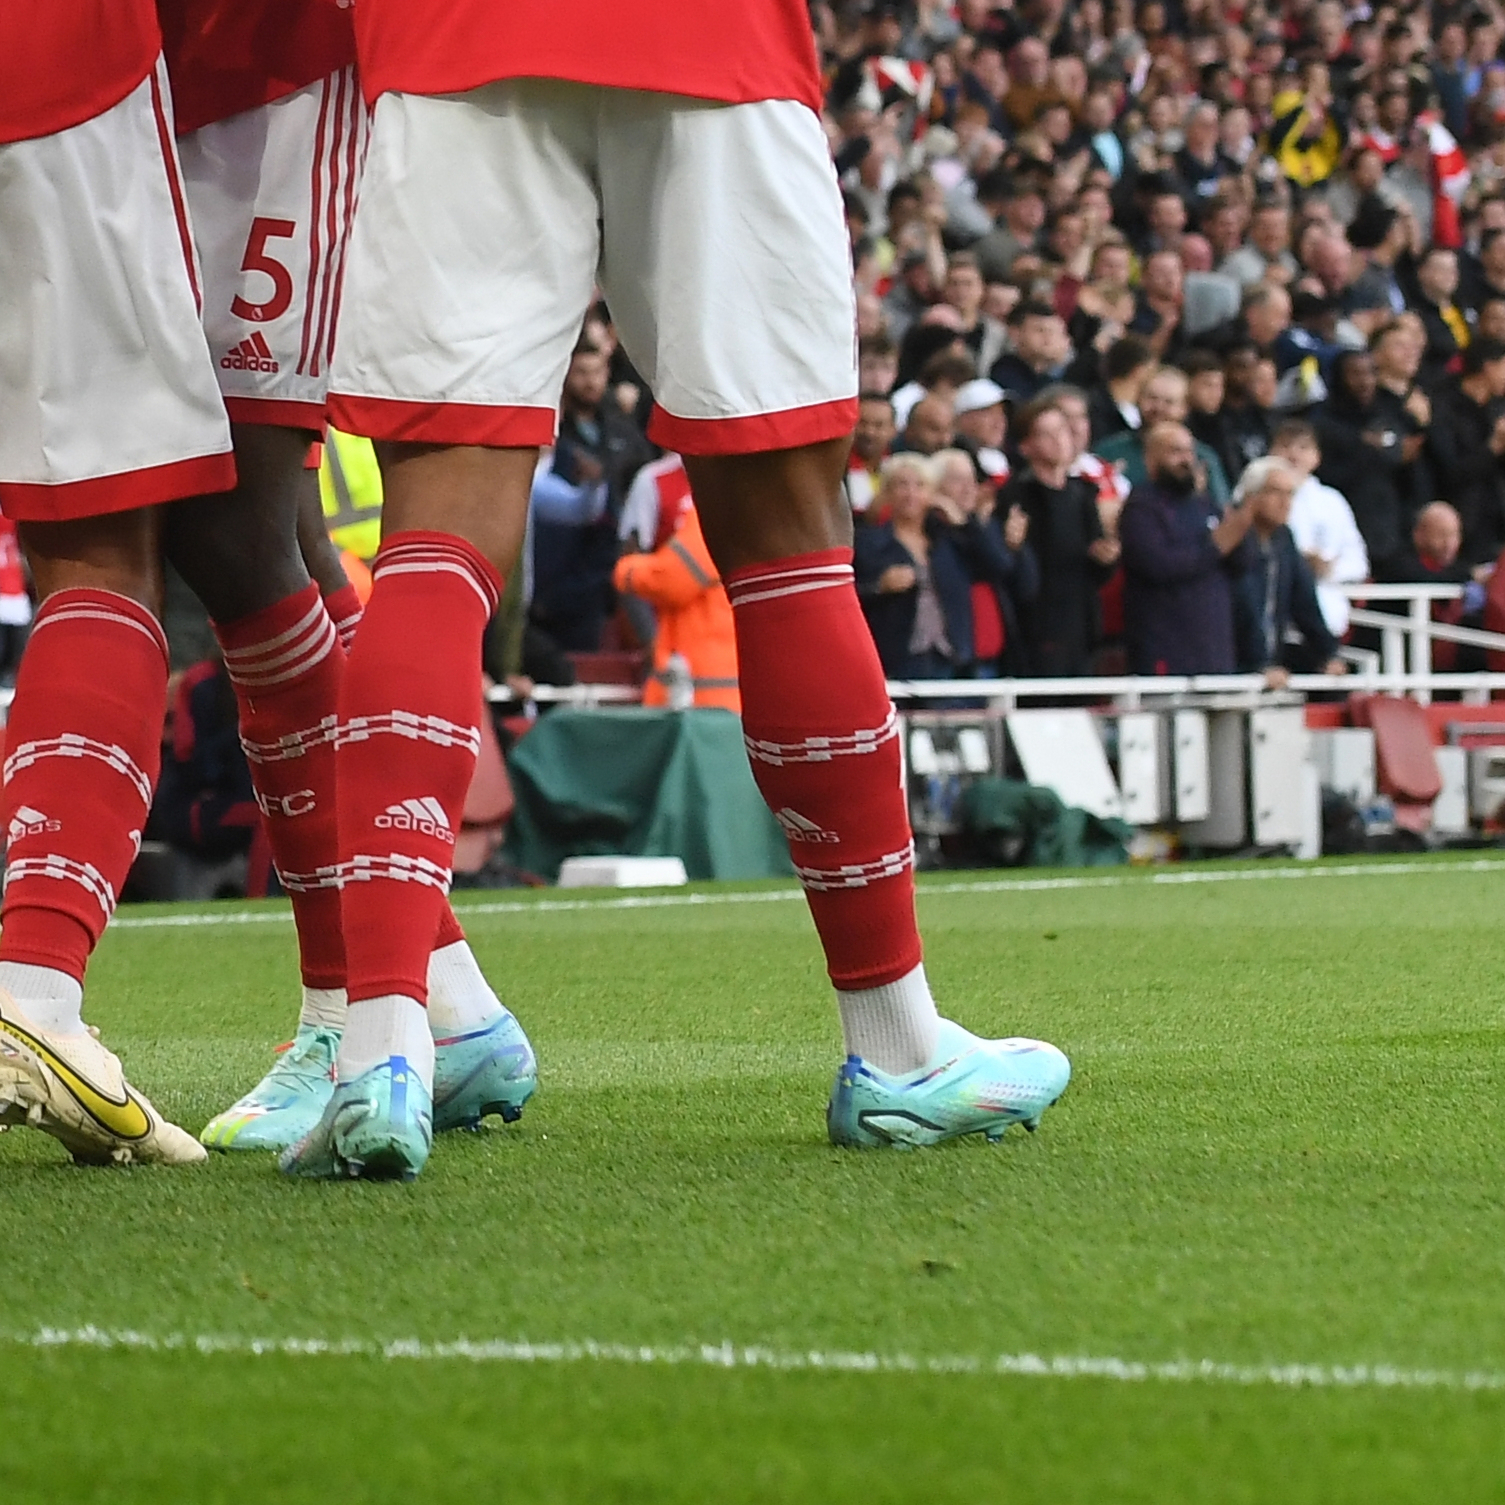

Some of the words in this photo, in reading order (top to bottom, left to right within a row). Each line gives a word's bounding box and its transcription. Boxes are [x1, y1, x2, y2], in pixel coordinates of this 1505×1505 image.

[230, 216, 297, 323] 5
[220, 355, 279, 373] adidas
[374, 812, 456, 845] adidas
